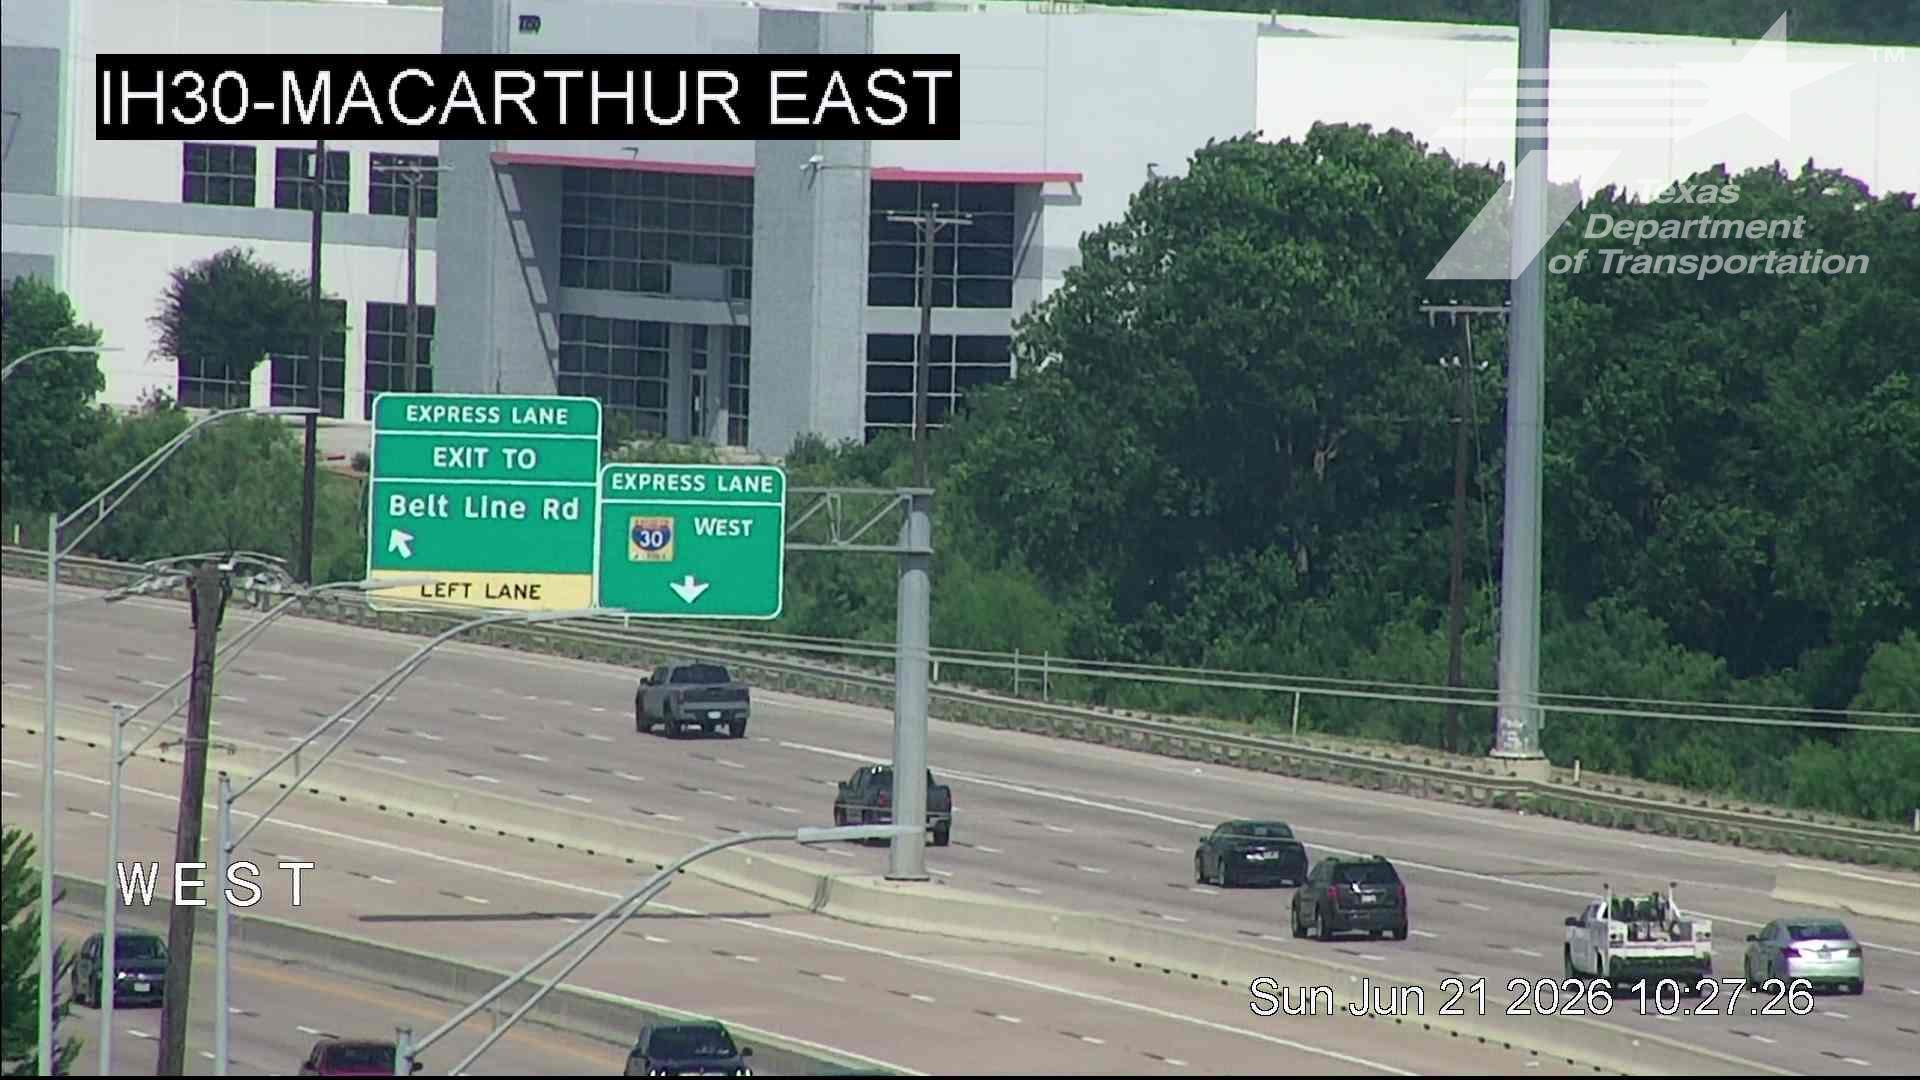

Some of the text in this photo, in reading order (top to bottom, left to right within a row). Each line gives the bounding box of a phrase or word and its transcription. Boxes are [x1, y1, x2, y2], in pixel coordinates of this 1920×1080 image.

[406, 404, 569, 425] EXPRESS LANE
[433, 446, 536, 469] EXIT TO
[611, 472, 773, 494] EXPRESS LANE
[389, 494, 579, 520] Belt Line Rd
[694, 517, 753, 537] WEST
[639, 530, 664, 548] 30
[420, 582, 542, 600] LEFT LANE
